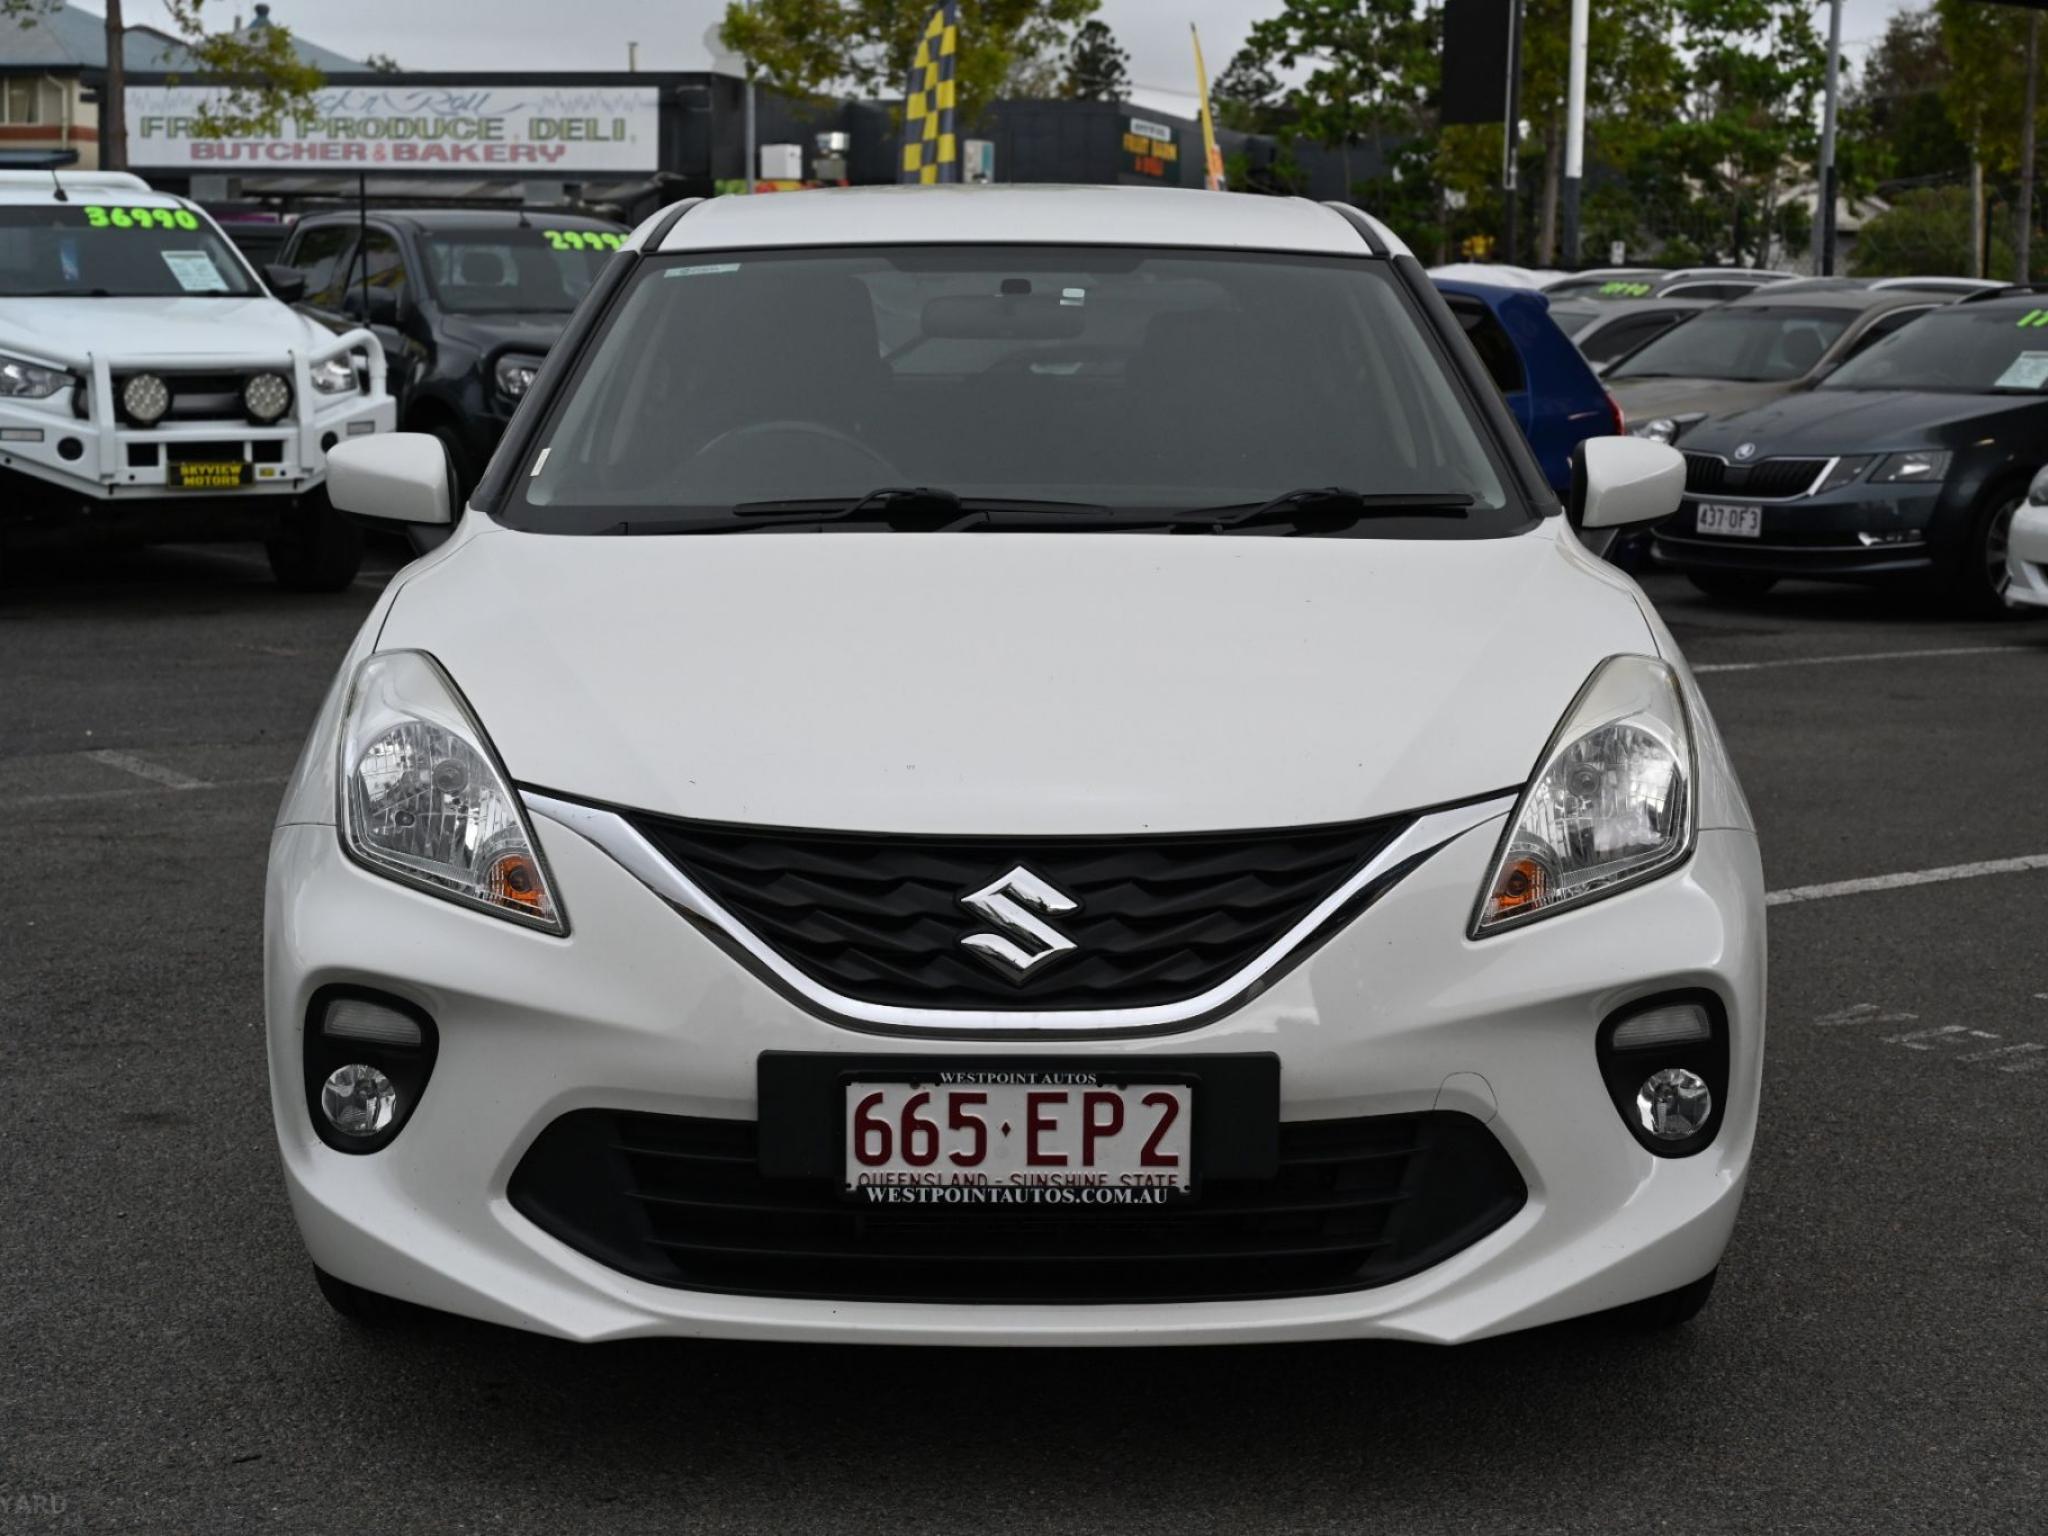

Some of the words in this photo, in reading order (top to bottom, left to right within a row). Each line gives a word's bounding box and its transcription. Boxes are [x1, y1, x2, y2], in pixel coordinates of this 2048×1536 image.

[140, 117, 283, 140] FRH
[191, 142, 367, 161] BUTCHER
[392, 143, 566, 162] BAKERY
[84, 205, 199, 230] 36990
[183, 476, 241, 488] MOTORS
[940, 1072, 1040, 1084] WESTPOINT
[1042, 1072, 1097, 1084] AUTOS
[858, 1172, 988, 1187] QUEENSLAND
[1009, 1173, 1108, 1187] SUNSHINE
[1120, 1173, 1178, 1187] STATE
[866, 1187, 1168, 1204] WESTPOINTAUTOS.COM.AU
